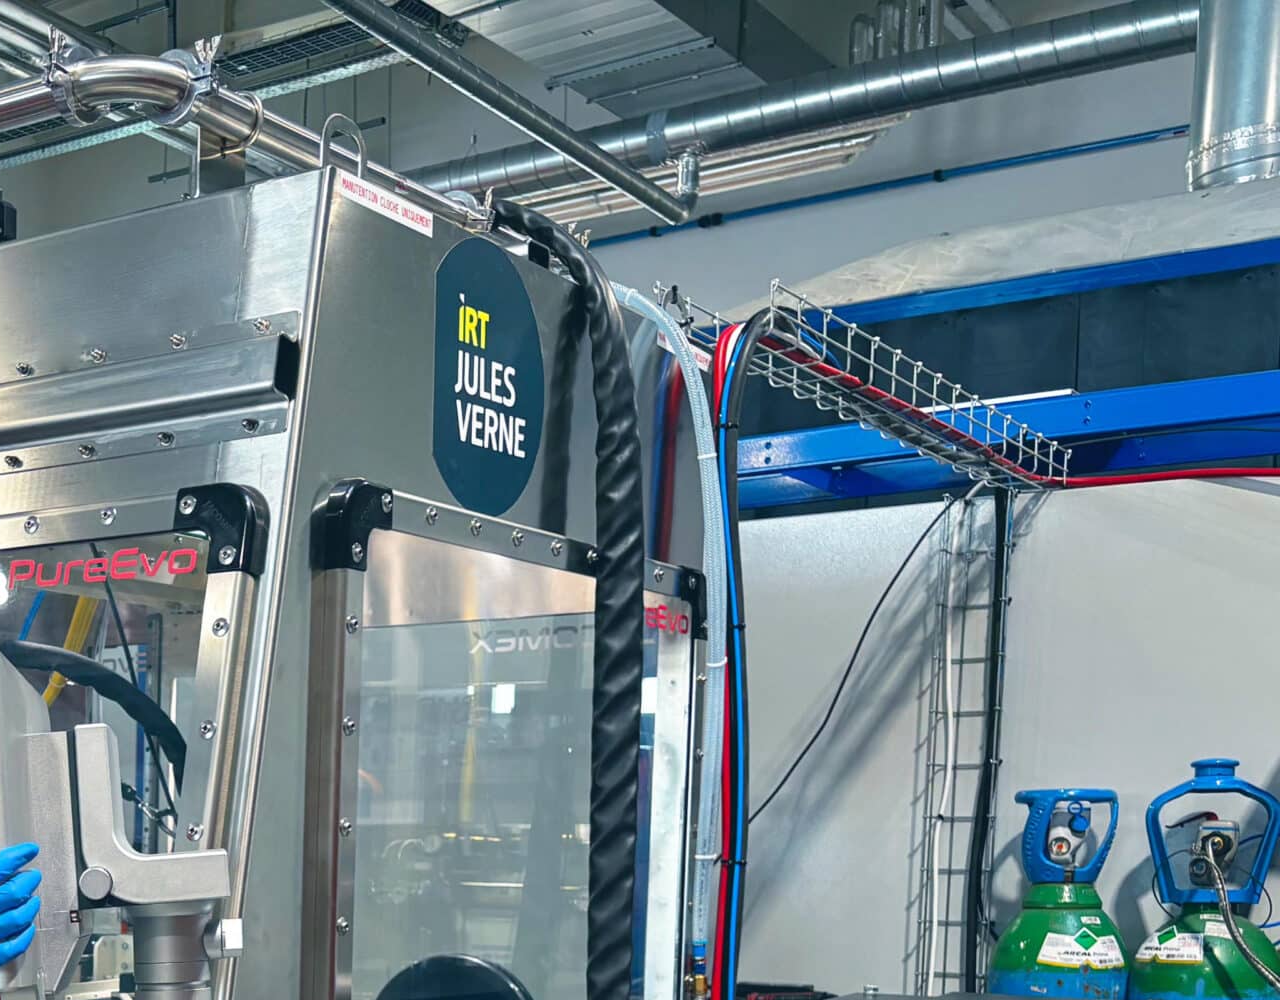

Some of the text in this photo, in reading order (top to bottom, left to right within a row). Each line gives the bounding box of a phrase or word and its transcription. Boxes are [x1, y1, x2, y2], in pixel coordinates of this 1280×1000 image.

[454, 350, 516, 408] JULES
[456, 399, 526, 459] VERNE
[8, 547, 198, 590] PureEvo
